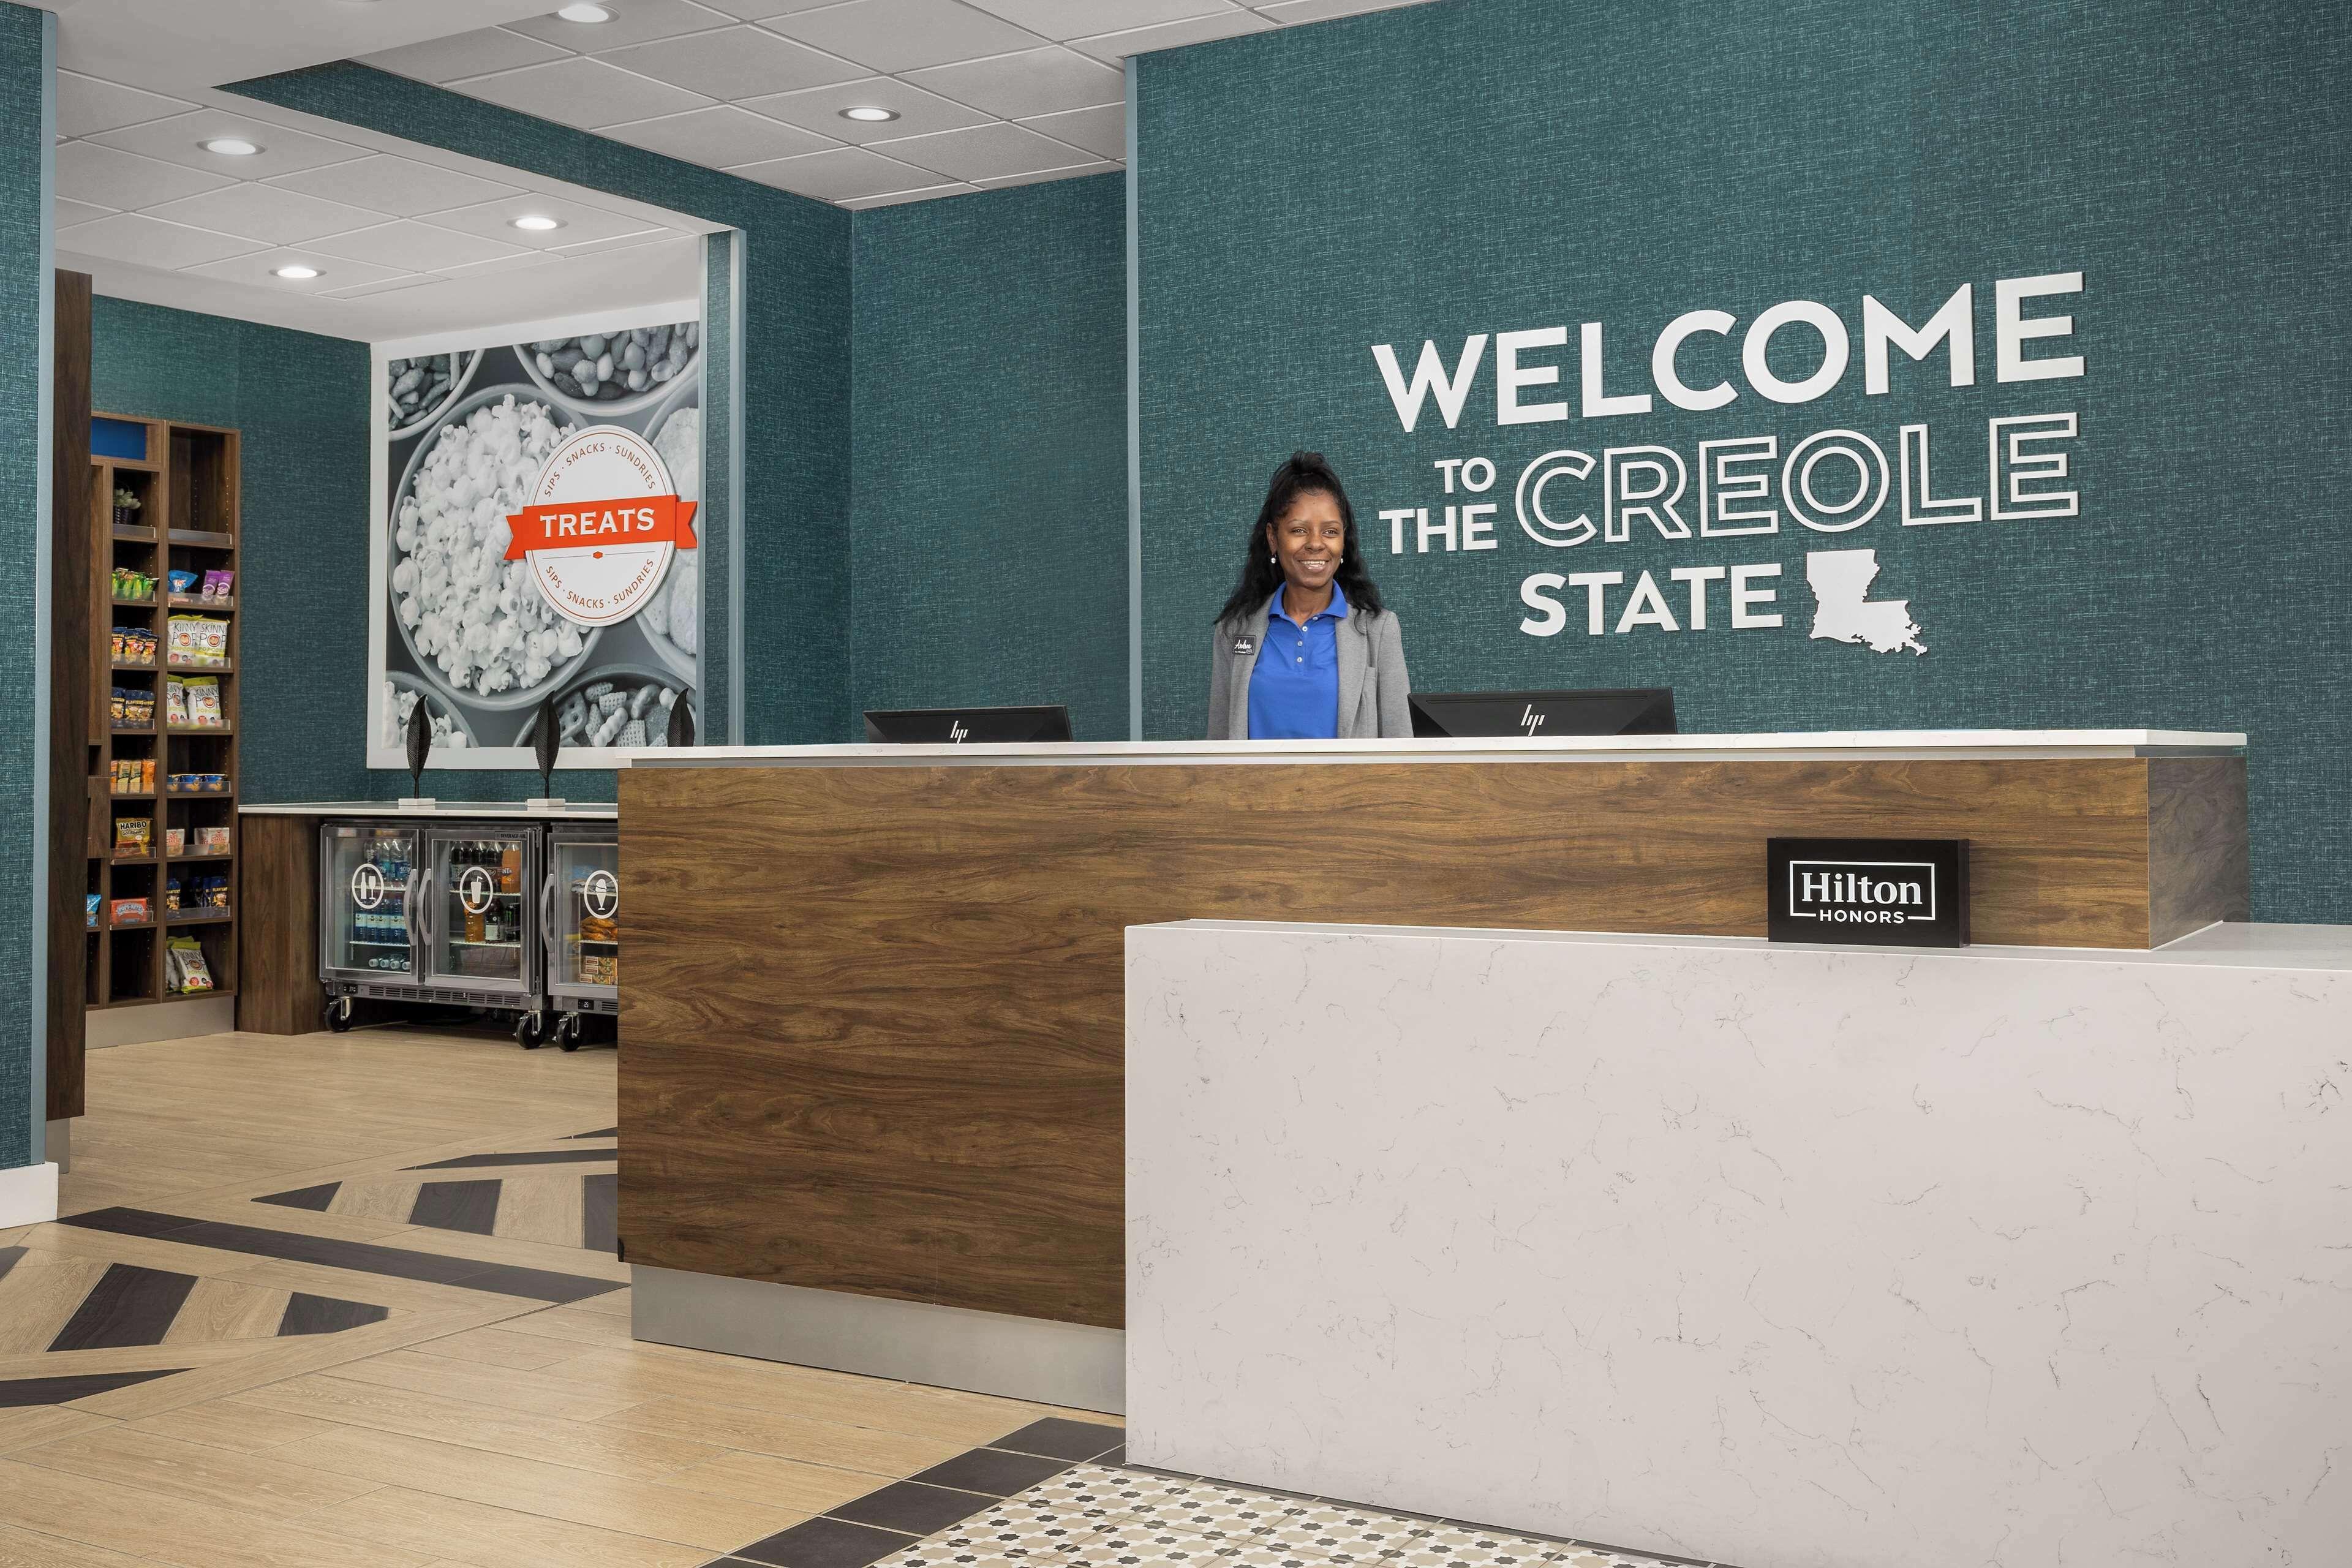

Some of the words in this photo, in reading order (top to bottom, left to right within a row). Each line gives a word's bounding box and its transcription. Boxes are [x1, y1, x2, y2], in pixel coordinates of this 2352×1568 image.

[1371, 271, 2085, 432] WELCOME
[545, 471, 560, 497] SIPS
[566, 442, 605, 466] SNACKS
[615, 445, 656, 489] SUNDRIES
[1434, 457, 1496, 493] TO
[1515, 412, 2078, 548] CREOLE
[540, 508, 655, 538] TREATS
[1379, 503, 1498, 554] THE
[546, 566, 562, 589] SIPS
[567, 590, 605, 608] SNACKS
[613, 559, 654, 605] SUNDRIES
[1519, 563, 1784, 637] STATE
[950, 720, 968, 744] hp
[1520, 704, 1545, 737] hp
[119, 820, 148, 831] HARIBO
[1801, 872, 1923, 905] Hilton
[1819, 909, 1905, 924] HONORS
